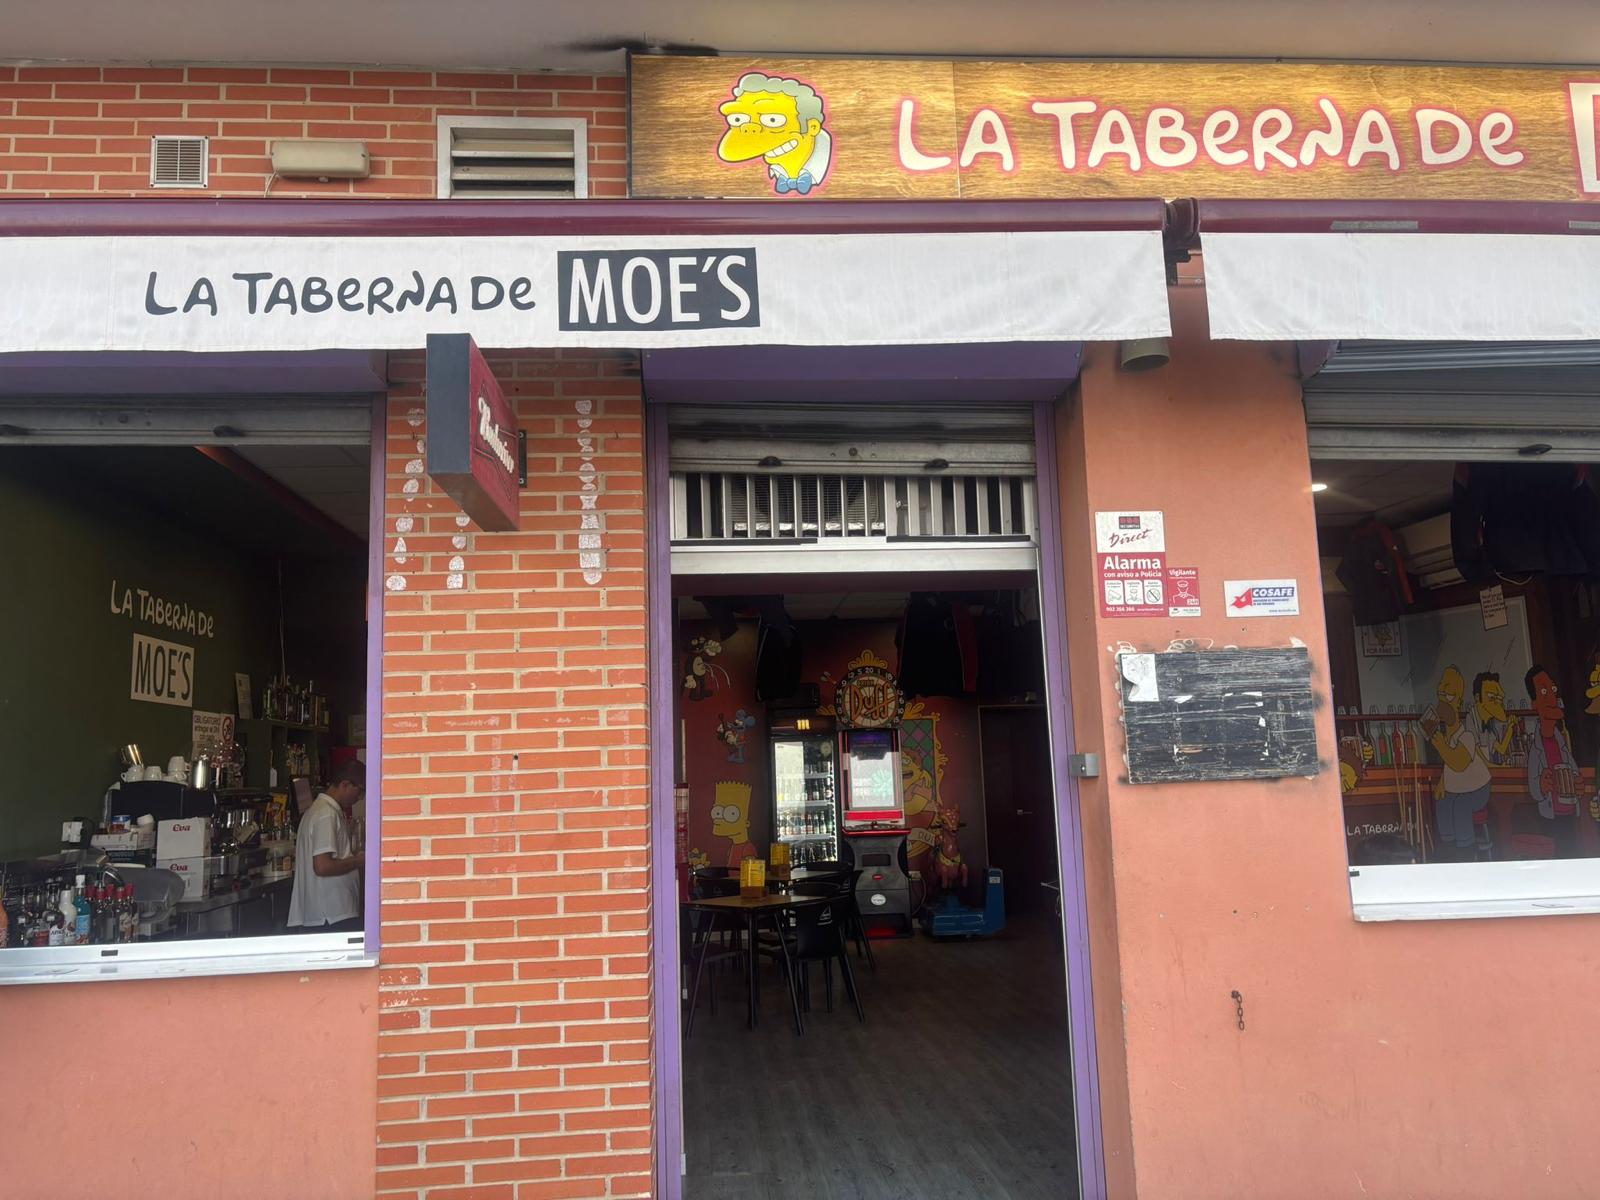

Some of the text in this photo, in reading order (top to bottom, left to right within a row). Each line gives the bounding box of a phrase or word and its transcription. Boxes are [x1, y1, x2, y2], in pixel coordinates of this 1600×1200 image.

[898, 98, 1019, 173] LA
[145, 270, 219, 317] LA
[567, 254, 752, 325] MOE'S
[1108, 529, 1152, 548] Direct
[1103, 554, 1162, 570] Alarma
[1117, 570, 1134, 578] aviso
[1168, 569, 1197, 577] Vigilante
[110, 579, 133, 619] LA
[1252, 588, 1294, 597] COSAFE
[135, 640, 192, 701] MOE'S
[848, 681, 897, 721] Duff
